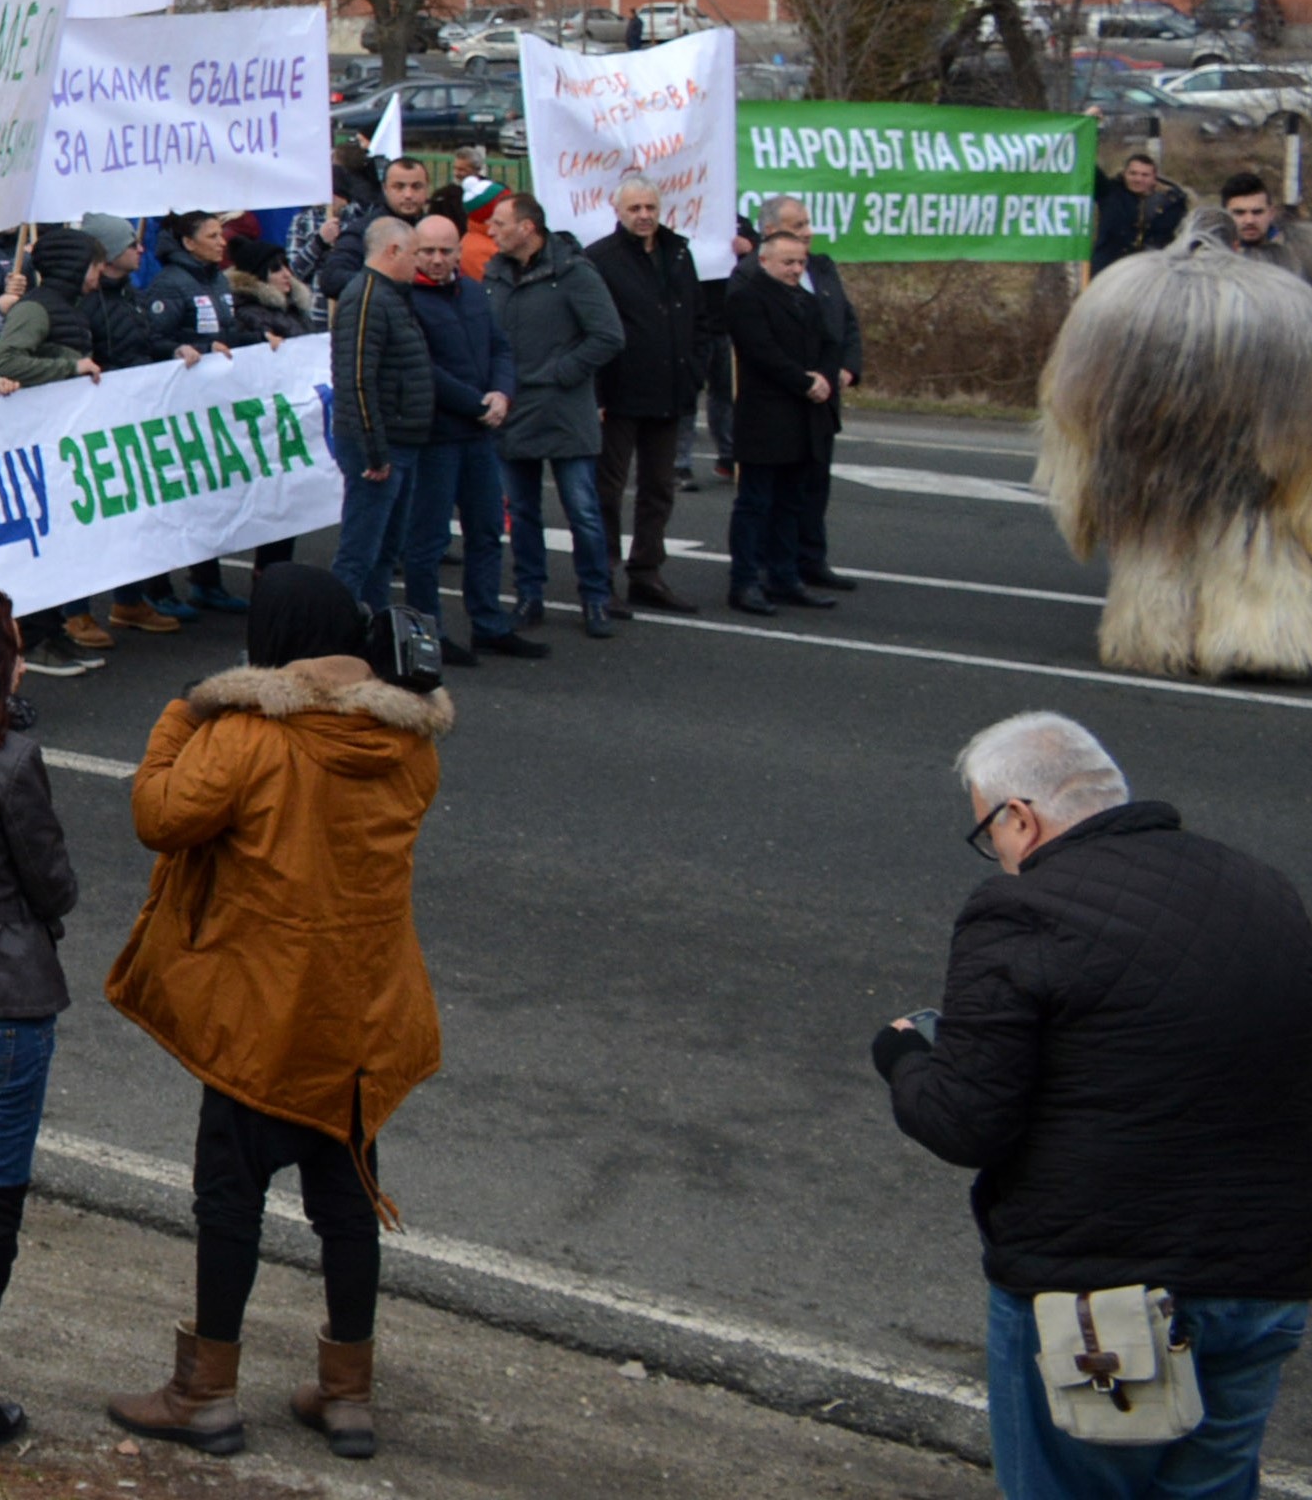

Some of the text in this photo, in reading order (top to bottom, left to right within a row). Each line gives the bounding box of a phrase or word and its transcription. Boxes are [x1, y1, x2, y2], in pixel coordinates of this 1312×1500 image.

[52, 55, 305, 108] ИСКАМЕ БЪДЕЩЕ
[54, 111, 279, 176] ЗА ДЕЦАТА СИ!
[749, 125, 1075, 178] НАРОДЪТ НА БАНСКО
[738, 190, 1092, 244] СЩУ ЗЕЛЕНИЯ РЕКЕТ!
[59, 392, 314, 525] ЗЕЛЕНАТА
